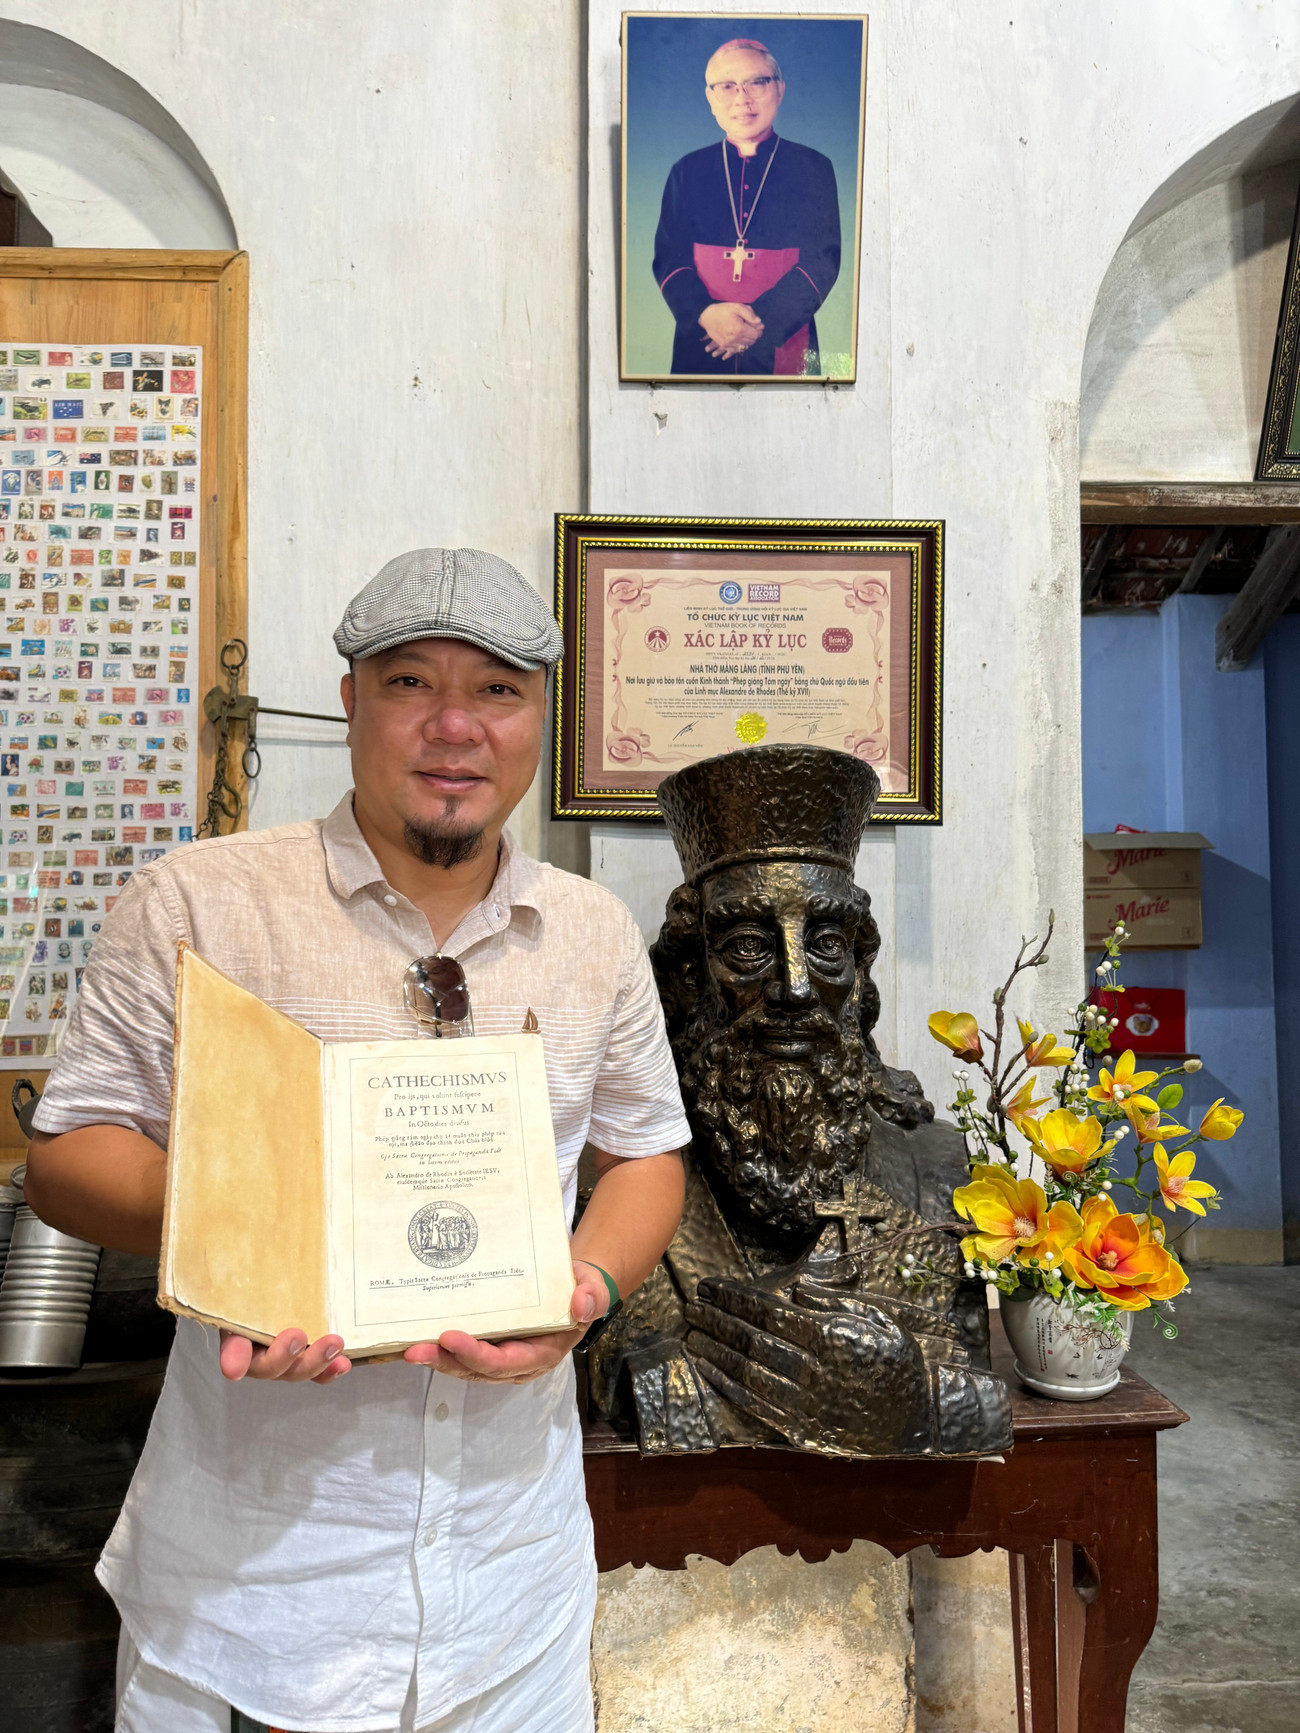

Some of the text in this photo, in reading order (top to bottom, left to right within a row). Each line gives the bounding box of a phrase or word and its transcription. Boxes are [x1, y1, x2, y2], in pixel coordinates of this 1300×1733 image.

[687, 611, 699, 621] TỔ
[702, 612, 726, 621] CHỨC
[729, 612, 740, 621] KỶ
[742, 614, 759, 623] LỤC
[761, 612, 780, 623] VIỆT
[683, 629, 715, 648] XÁC
[719, 630, 748, 651] LẬP
[752, 628, 773, 648] KỶ
[778, 634, 807, 651] LỤC
[690, 663, 704, 673] NHÀ
[705, 662, 718, 673] THỜ
[758, 662, 775, 675] (TỈNH
[777, 663, 790, 674] PHÚ
[791, 664, 805, 675] YÊN)
[626, 676, 635, 684] Nơi
[637, 676, 645, 684] lưu
[656, 676, 663, 684] và
[686, 676, 699, 684] cuốn
[700, 676, 712, 684] Kinh
[713, 676, 729, 684] thánh
[820, 677, 834, 685] Quốc
[684, 687, 693, 695] của
[695, 687, 706, 695] Linh
[708, 689, 718, 697] mục
[720, 687, 747, 695] Alexandre
[748, 687, 755, 695] de
[756, 687, 775, 695] Rhodes
[797, 688, 810, 697] XVII)
[1107, 896, 1170, 931] Marie
[368, 1071, 507, 1089] CATHECHISMVS
[384, 1103, 495, 1117] BAPTISMVM
[478, 1269, 507, 1277] Propaganda
